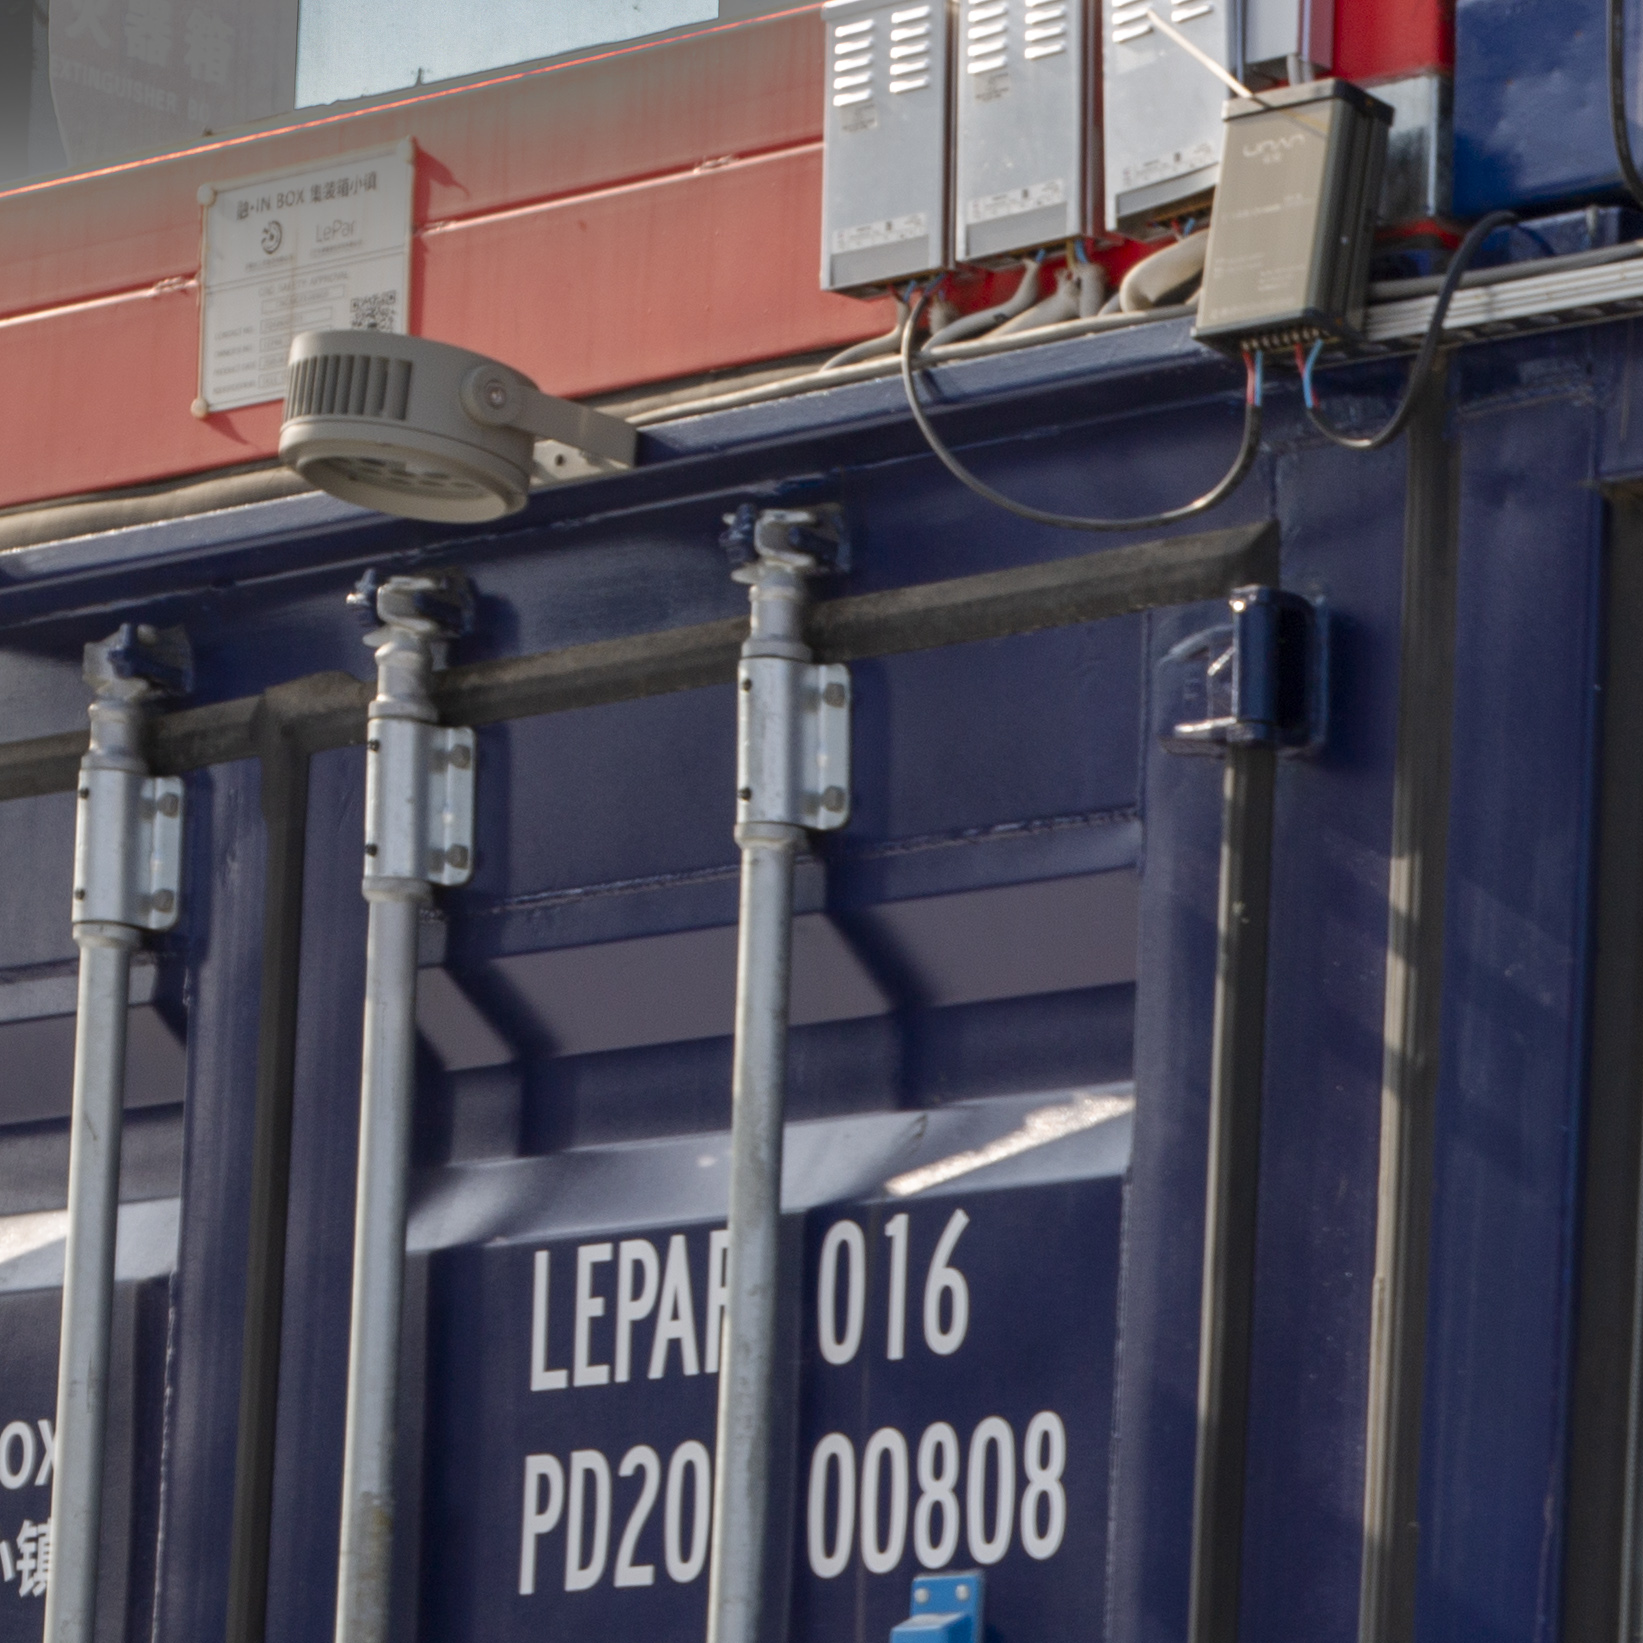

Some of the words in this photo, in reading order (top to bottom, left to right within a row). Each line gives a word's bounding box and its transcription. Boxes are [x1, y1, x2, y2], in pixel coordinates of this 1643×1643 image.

[277, 190, 304, 209] BOX
[315, 218, 357, 243] LePar
[818, 1208, 970, 1365] 016
